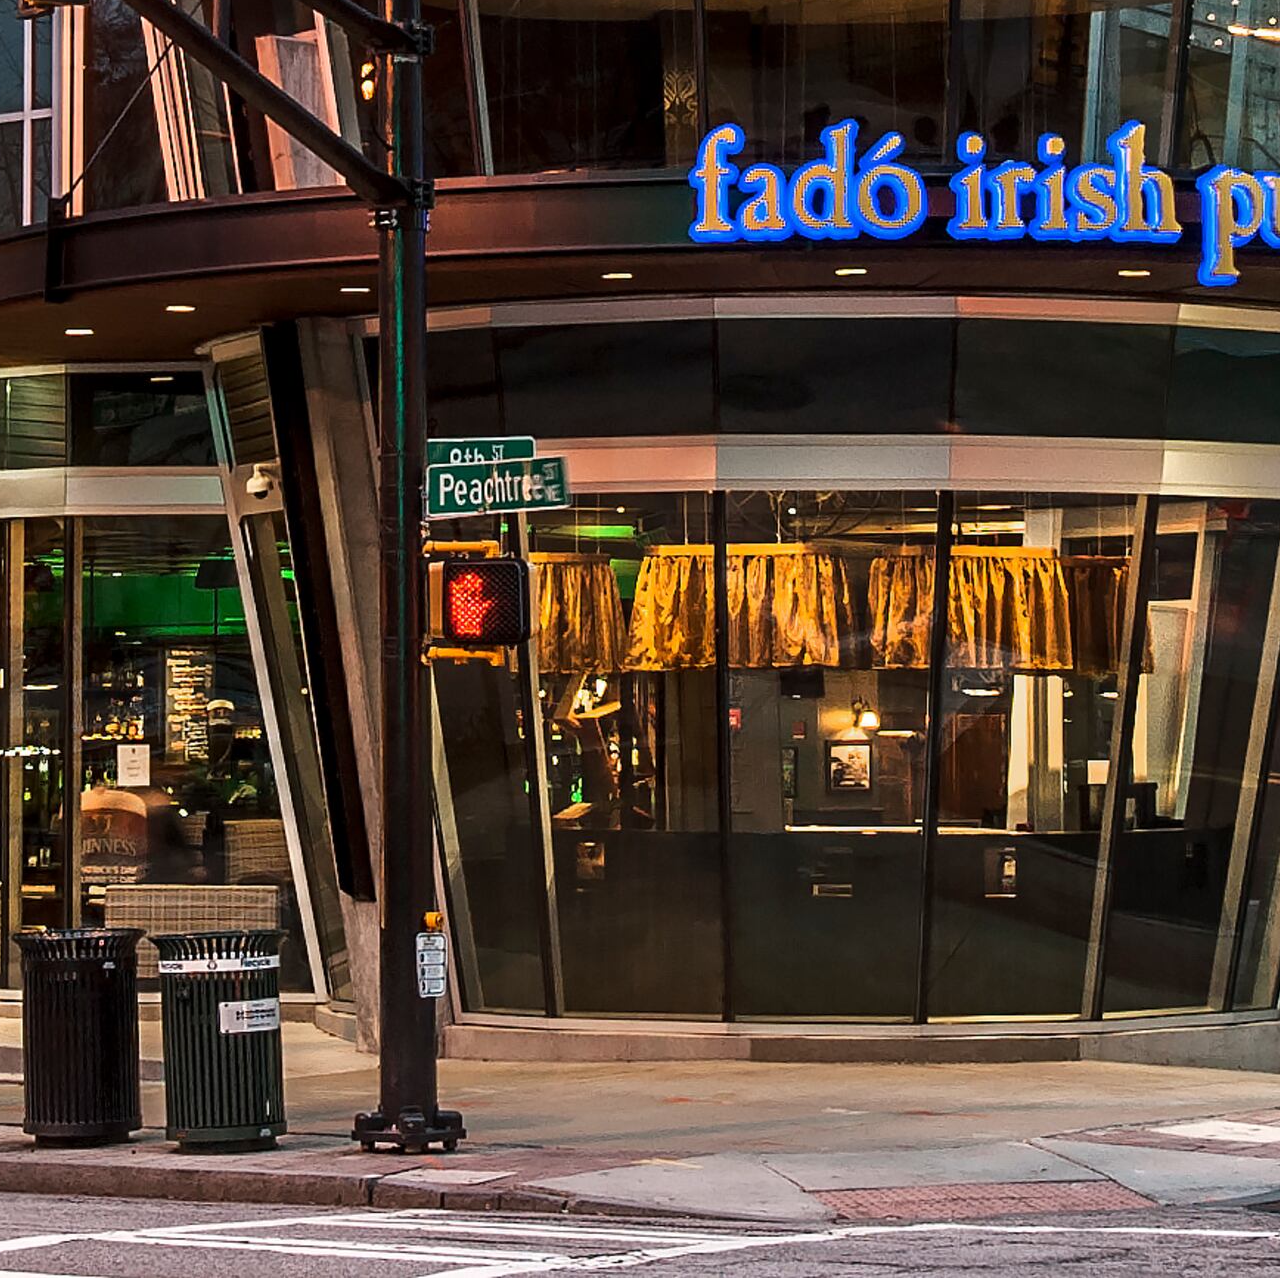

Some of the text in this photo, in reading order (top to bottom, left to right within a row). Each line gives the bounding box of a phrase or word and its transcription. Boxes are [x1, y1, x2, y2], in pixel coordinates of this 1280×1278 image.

[690, 119, 929, 242] fadó
[948, 120, 1182, 242] irish
[439, 469, 543, 505] Peachtree
[544, 484, 563, 502] NE
